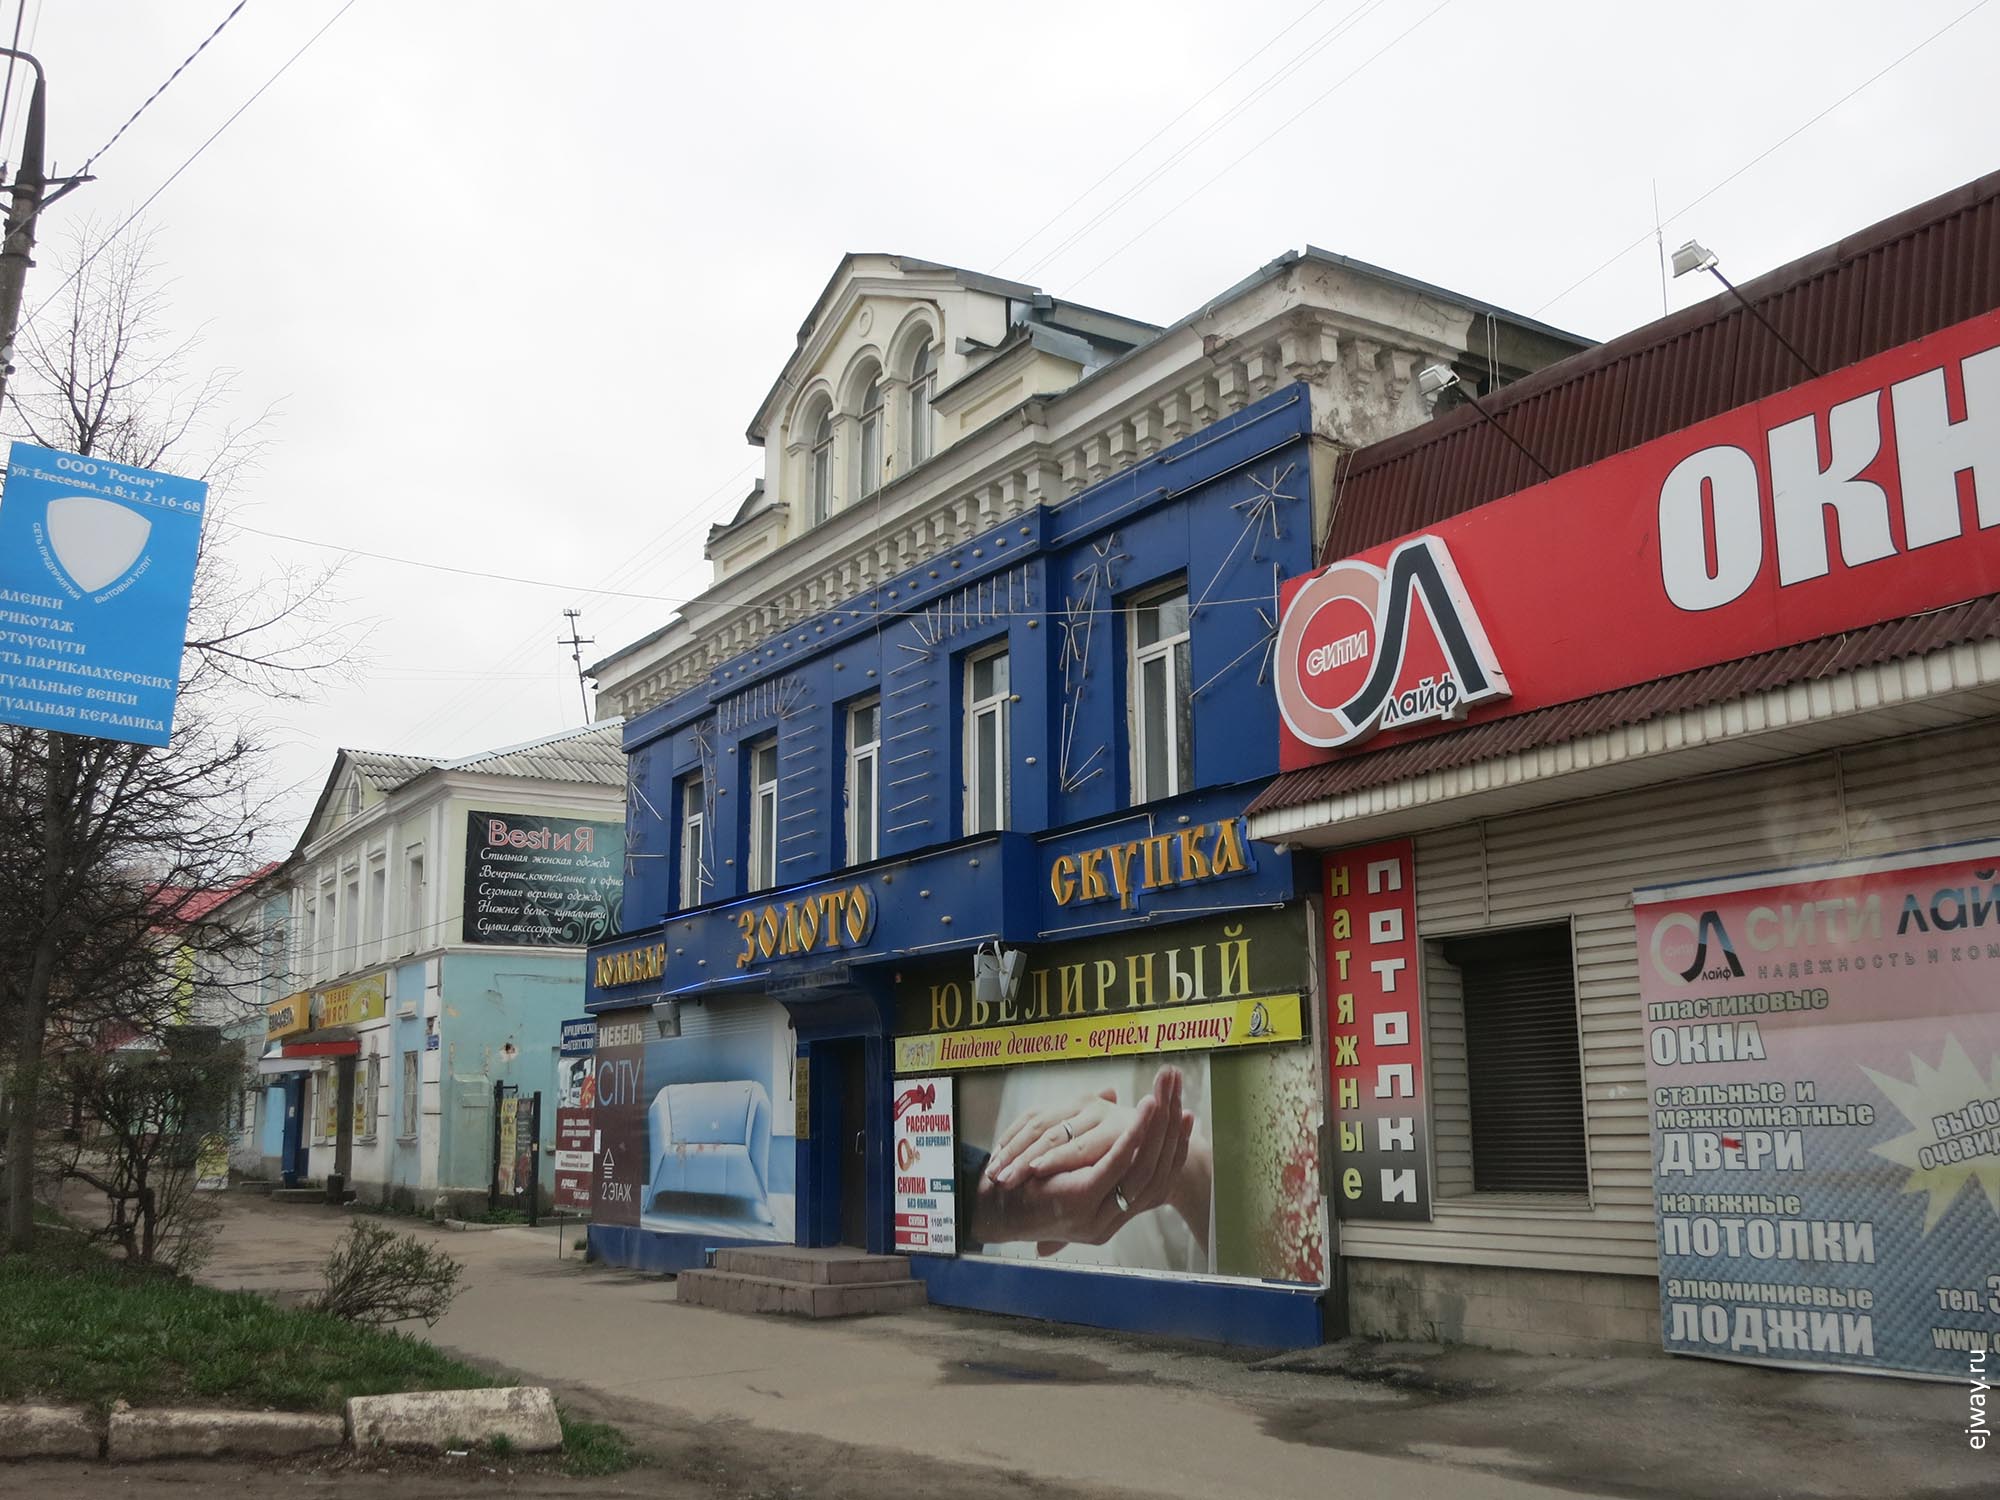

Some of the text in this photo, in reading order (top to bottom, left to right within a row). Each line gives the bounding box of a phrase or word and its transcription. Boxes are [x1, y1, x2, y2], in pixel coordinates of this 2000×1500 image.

[56, 457, 98, 475] ООО
[11, 466, 31, 478] ул.
[143, 491, 201, 513] 2-16-68
[33, 521, 43, 545] СЕТЬ
[25, 655, 173, 690] ПАРИКМАХЕРСКИХ
[86, 688, 138, 706] ВЕНКИ
[79, 707, 165, 732] КЕРАМИКА
[480, 848, 610, 868] Стильная женская одежда
[1050, 818, 1244, 911] СКУПКА
[478, 882, 602, 902] Сезонная верхняя одежда
[478, 900, 519, 915] Нижнее
[554, 909, 606, 921] купальники
[736, 884, 868, 969] ЗОЛОТО
[1648, 988, 1830, 1022] пластиковые
[600, 1023, 643, 1048] МЕБЕЛЬ
[1007, 1030, 1068, 1056] дешевле
[1089, 1020, 1149, 1053] вернём
[1155, 1015, 1234, 1049] разницу
[1650, 1020, 1767, 1067] ОКНА
[599, 1056, 642, 1106] CITY
[1655, 1081, 1786, 1107] стальные
[905, 1114, 951, 1133] РАССРОЧКА
[1656, 1103, 1875, 1130] межкомнатные
[1931, 1097, 2000, 1140] выбо
[1659, 1130, 1805, 1178] ДВЕРИ
[602, 1182, 608, 1201] 2
[608, 1183, 632, 1202] ЭТАЖ
[897, 1176, 926, 1194] СКУПКА
[907, 1198, 916, 1208] БЕЗ
[1661, 1193, 1801, 1216] натяжные
[1662, 1216, 1876, 1265] ПОТОЛКИ
[1667, 1278, 1874, 1310] алюминиевые
[1935, 1287, 1985, 1313] тел.
[1669, 1302, 1875, 1357] ЛОДЖИИ
